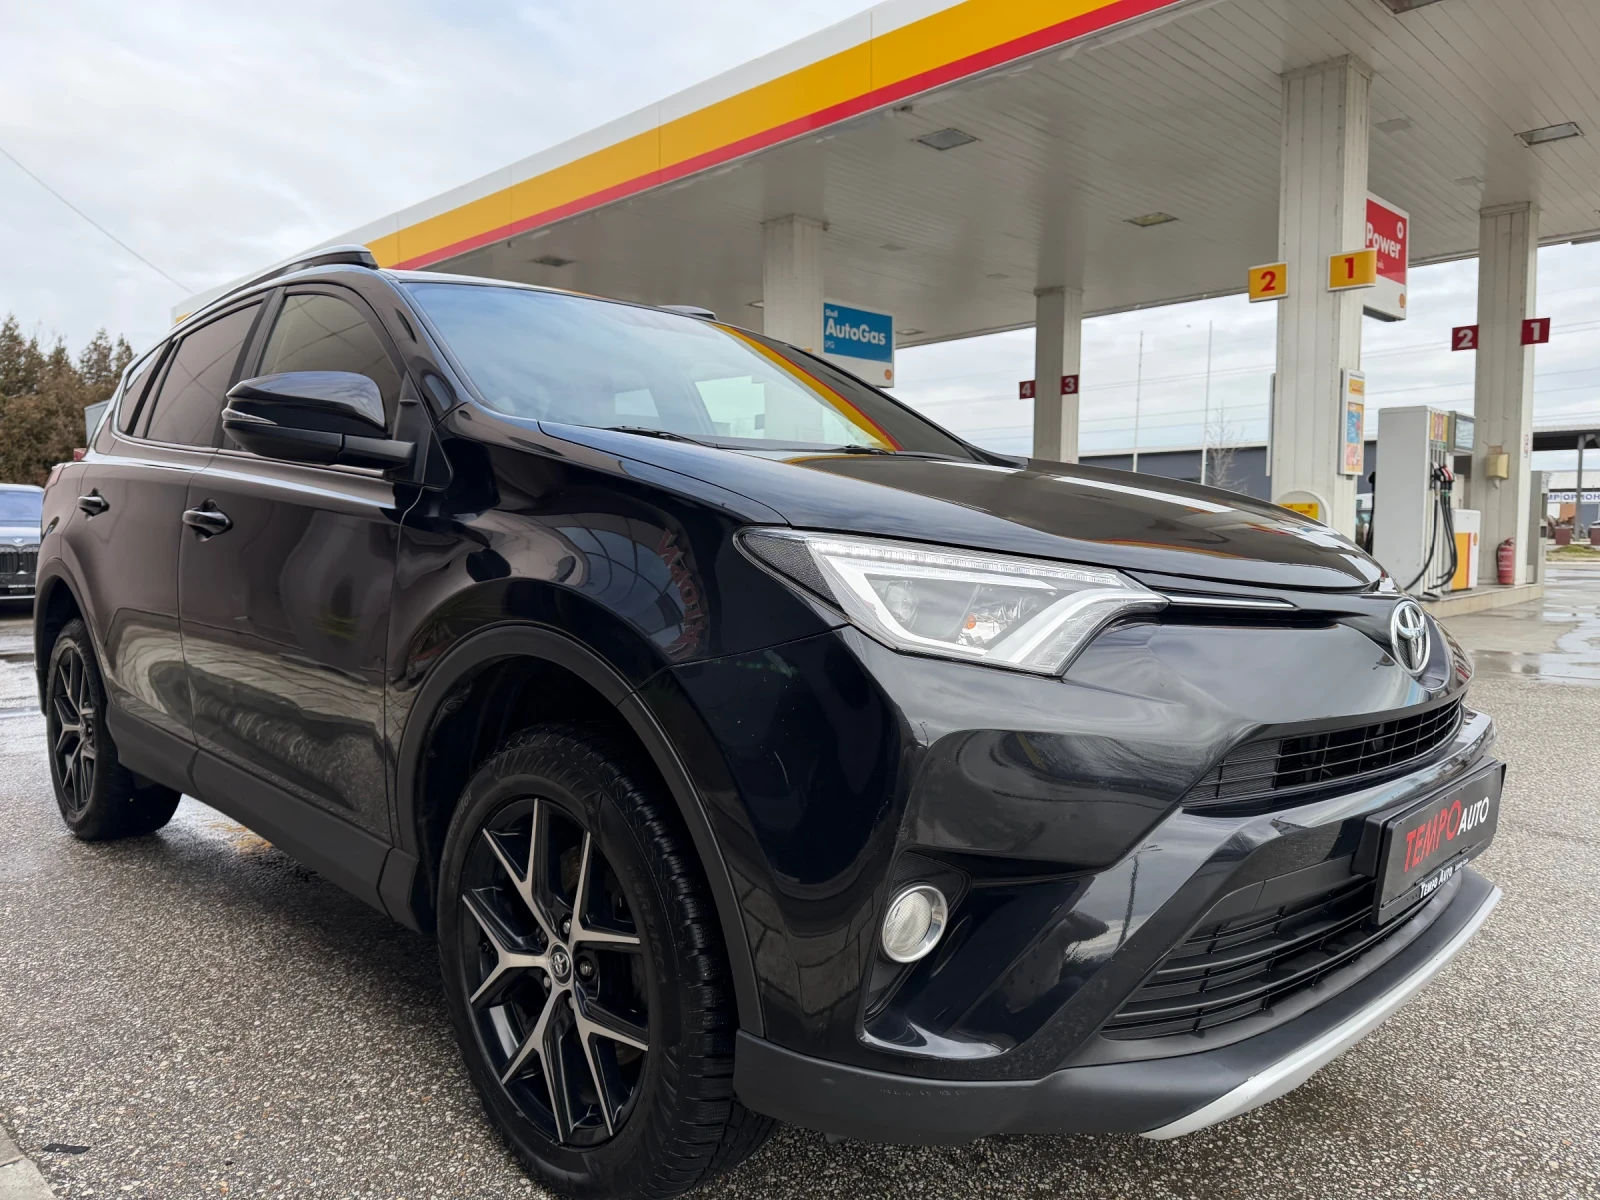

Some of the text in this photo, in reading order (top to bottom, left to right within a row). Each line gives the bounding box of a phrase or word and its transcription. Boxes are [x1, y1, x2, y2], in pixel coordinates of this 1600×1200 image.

[1344, 257, 1355, 279] 1
[1260, 270, 1276, 293] 2
[825, 318, 886, 345] AutoGas
[1457, 329, 1474, 348] 2
[1530, 322, 1541, 341] 1
[1021, 382, 1032, 397] 4
[1064, 377, 1075, 392] 3
